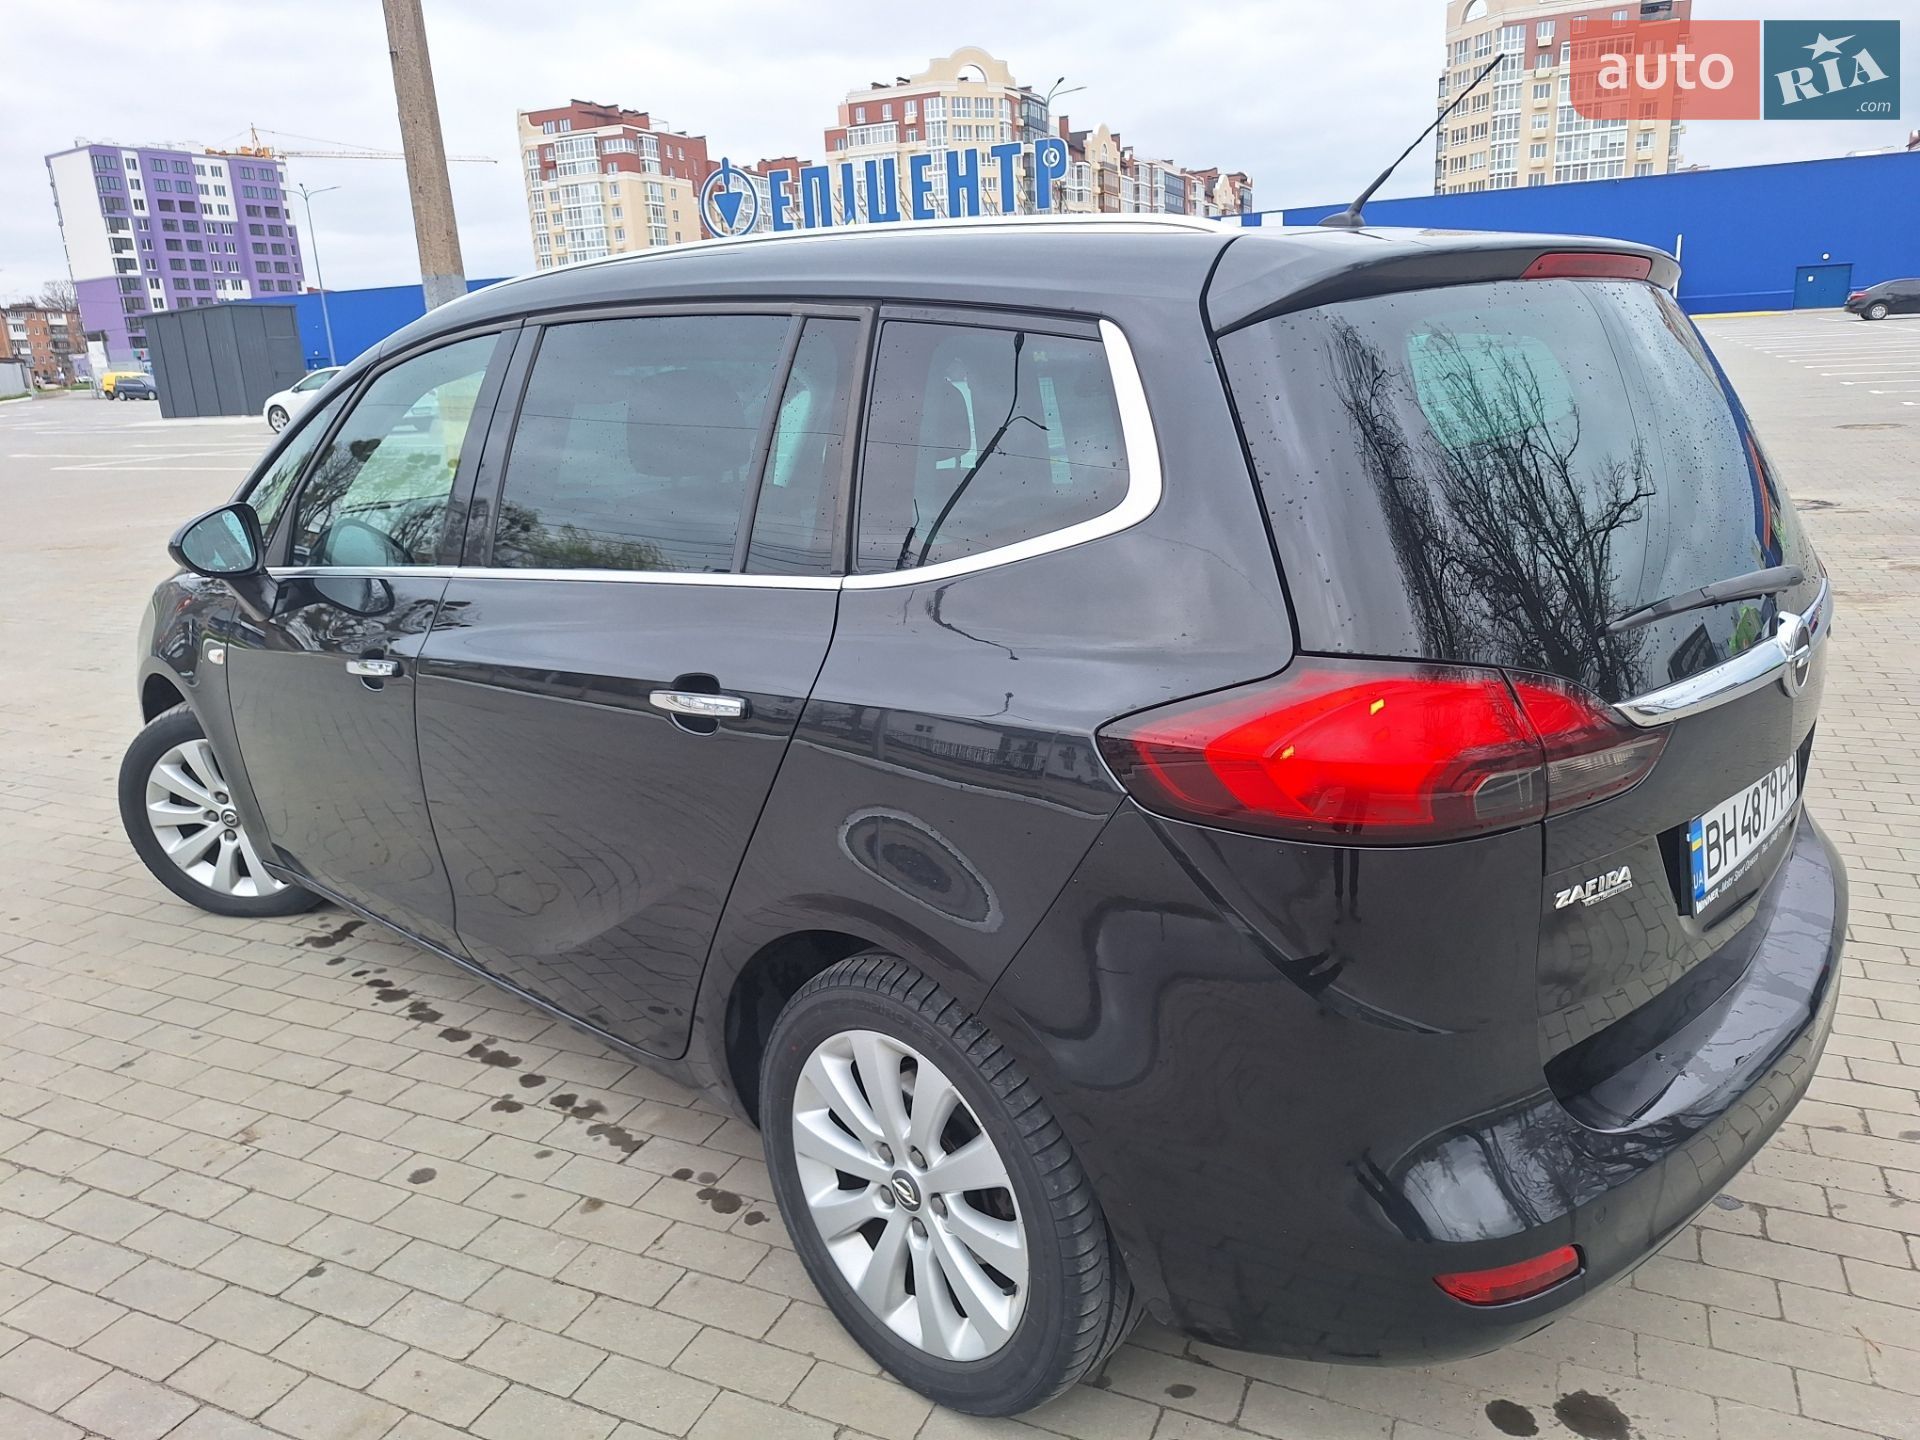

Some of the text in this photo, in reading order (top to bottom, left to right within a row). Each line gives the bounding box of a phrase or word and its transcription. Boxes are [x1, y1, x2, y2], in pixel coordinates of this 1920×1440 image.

[767, 136, 1068, 232] ЕПІЦЕНТР
[1706, 804, 1737, 880] BH
[1741, 768, 1777, 845] 4879
[1555, 866, 1632, 910] ZAFIRA
[1693, 869, 1704, 890] UA
